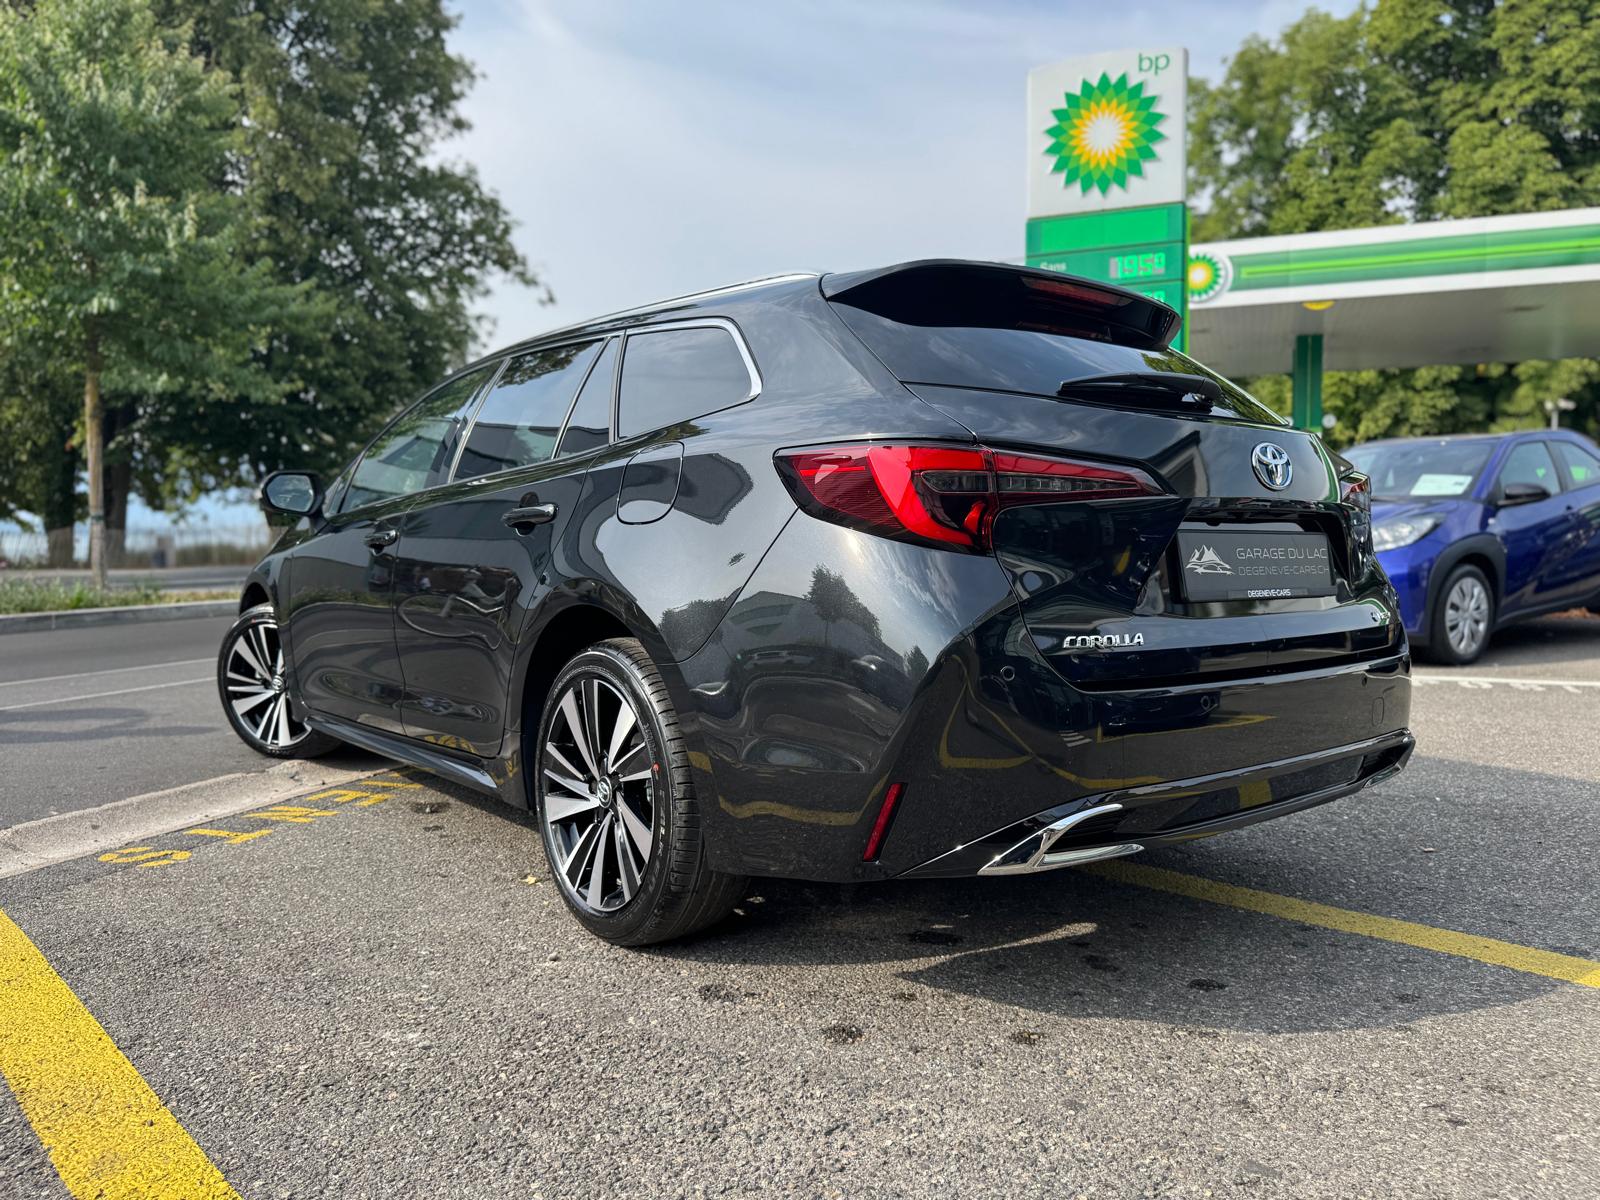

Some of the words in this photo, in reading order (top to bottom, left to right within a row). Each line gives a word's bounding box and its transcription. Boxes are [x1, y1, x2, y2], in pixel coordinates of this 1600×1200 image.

[1138, 53, 1170, 75] bp
[1236, 547, 1286, 560] GARAGE
[1287, 547, 1305, 559] DU
[1306, 547, 1328, 559] LAC
[1063, 633, 1145, 648] COROLLA
